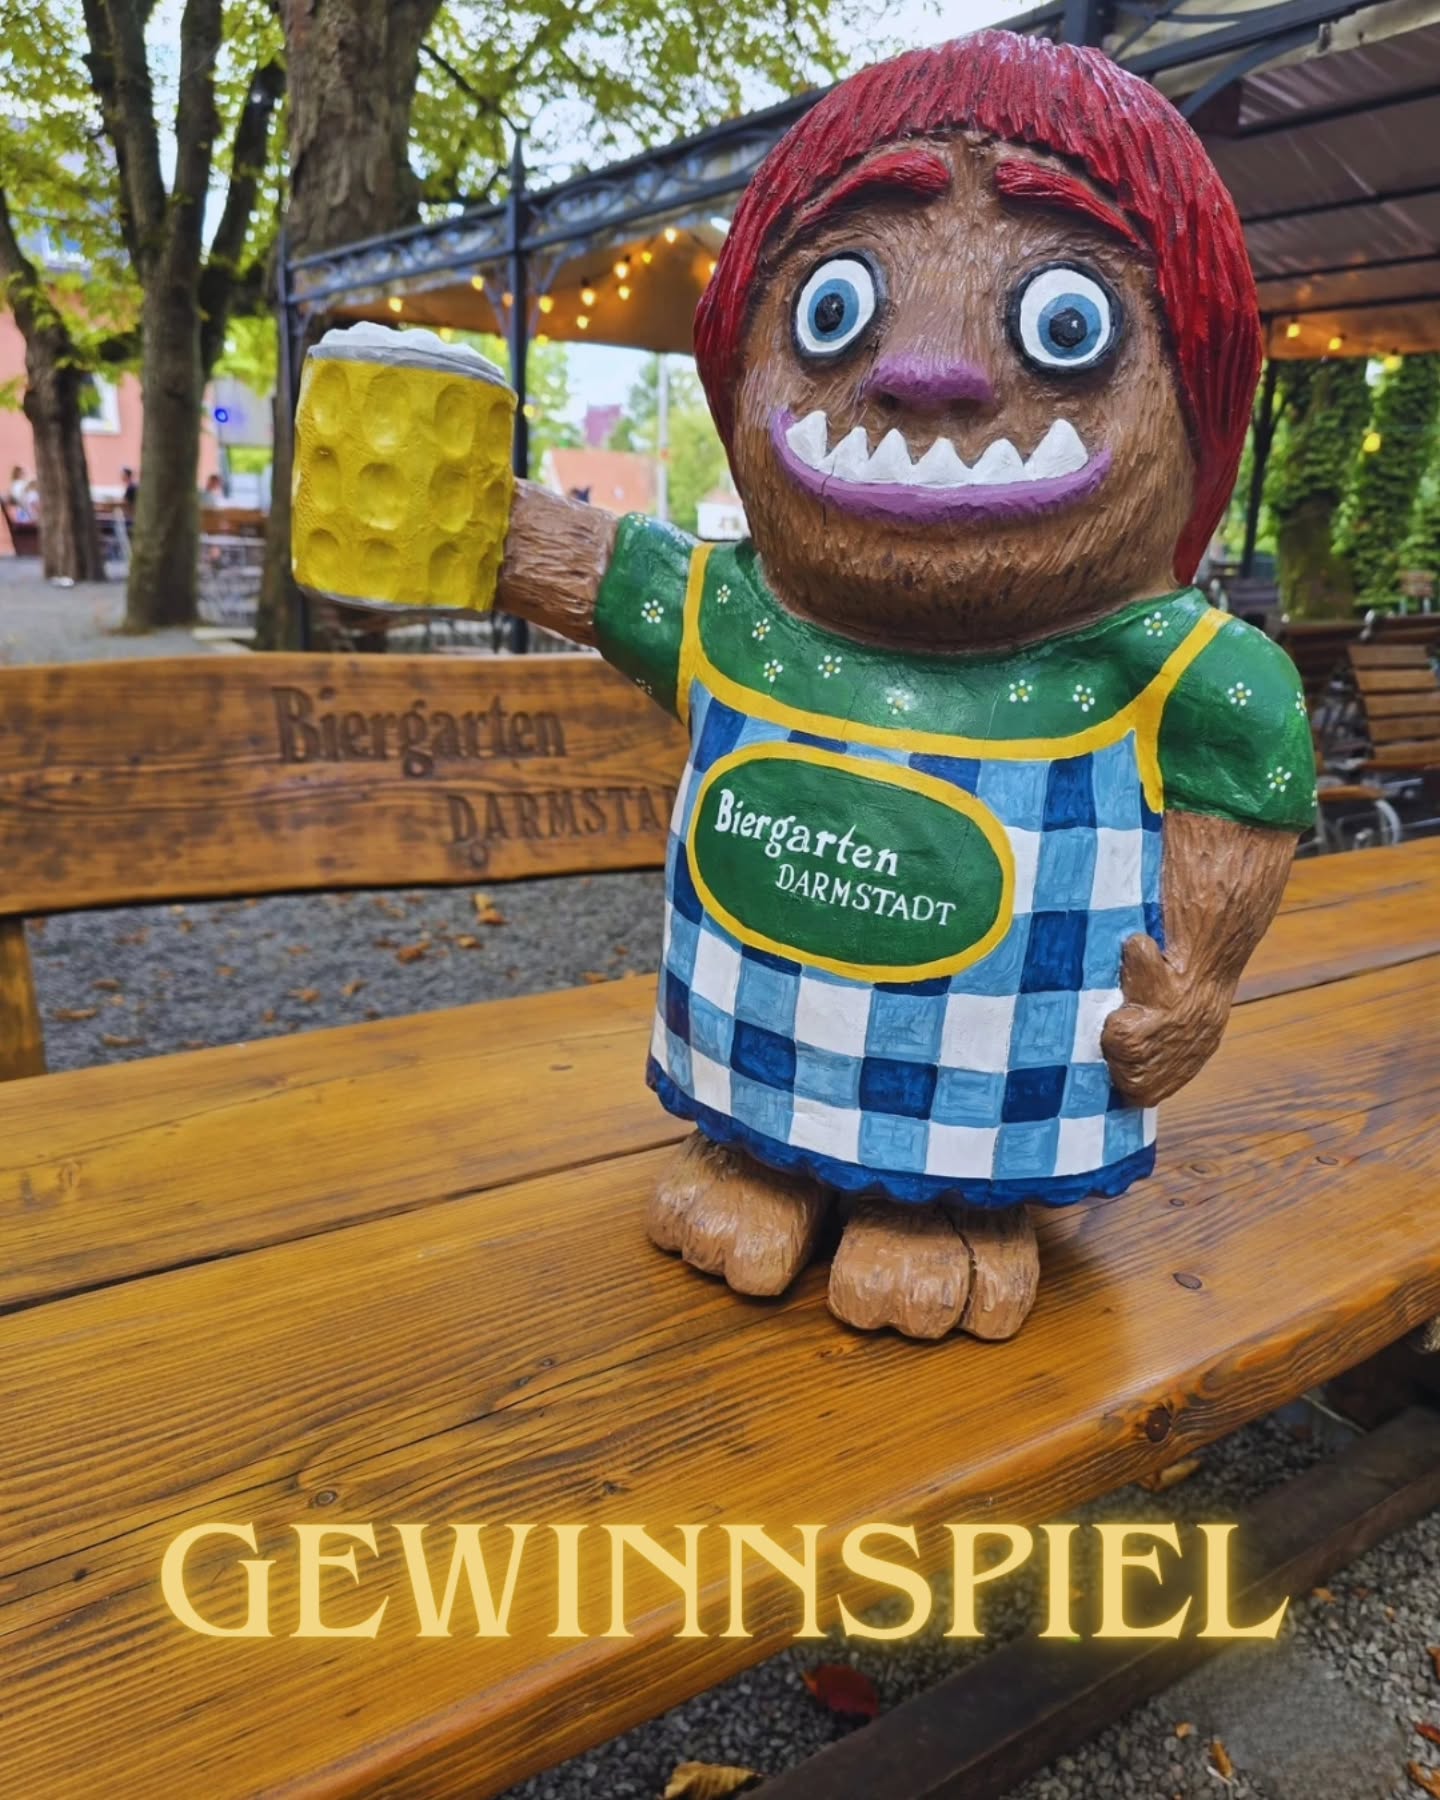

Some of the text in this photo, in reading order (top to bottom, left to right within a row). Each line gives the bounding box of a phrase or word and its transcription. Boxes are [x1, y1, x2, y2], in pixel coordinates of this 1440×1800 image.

[271, 686, 566, 778] Biergarten
[714, 787, 899, 876] Biergarten
[775, 863, 956, 926] DARMSTADT
